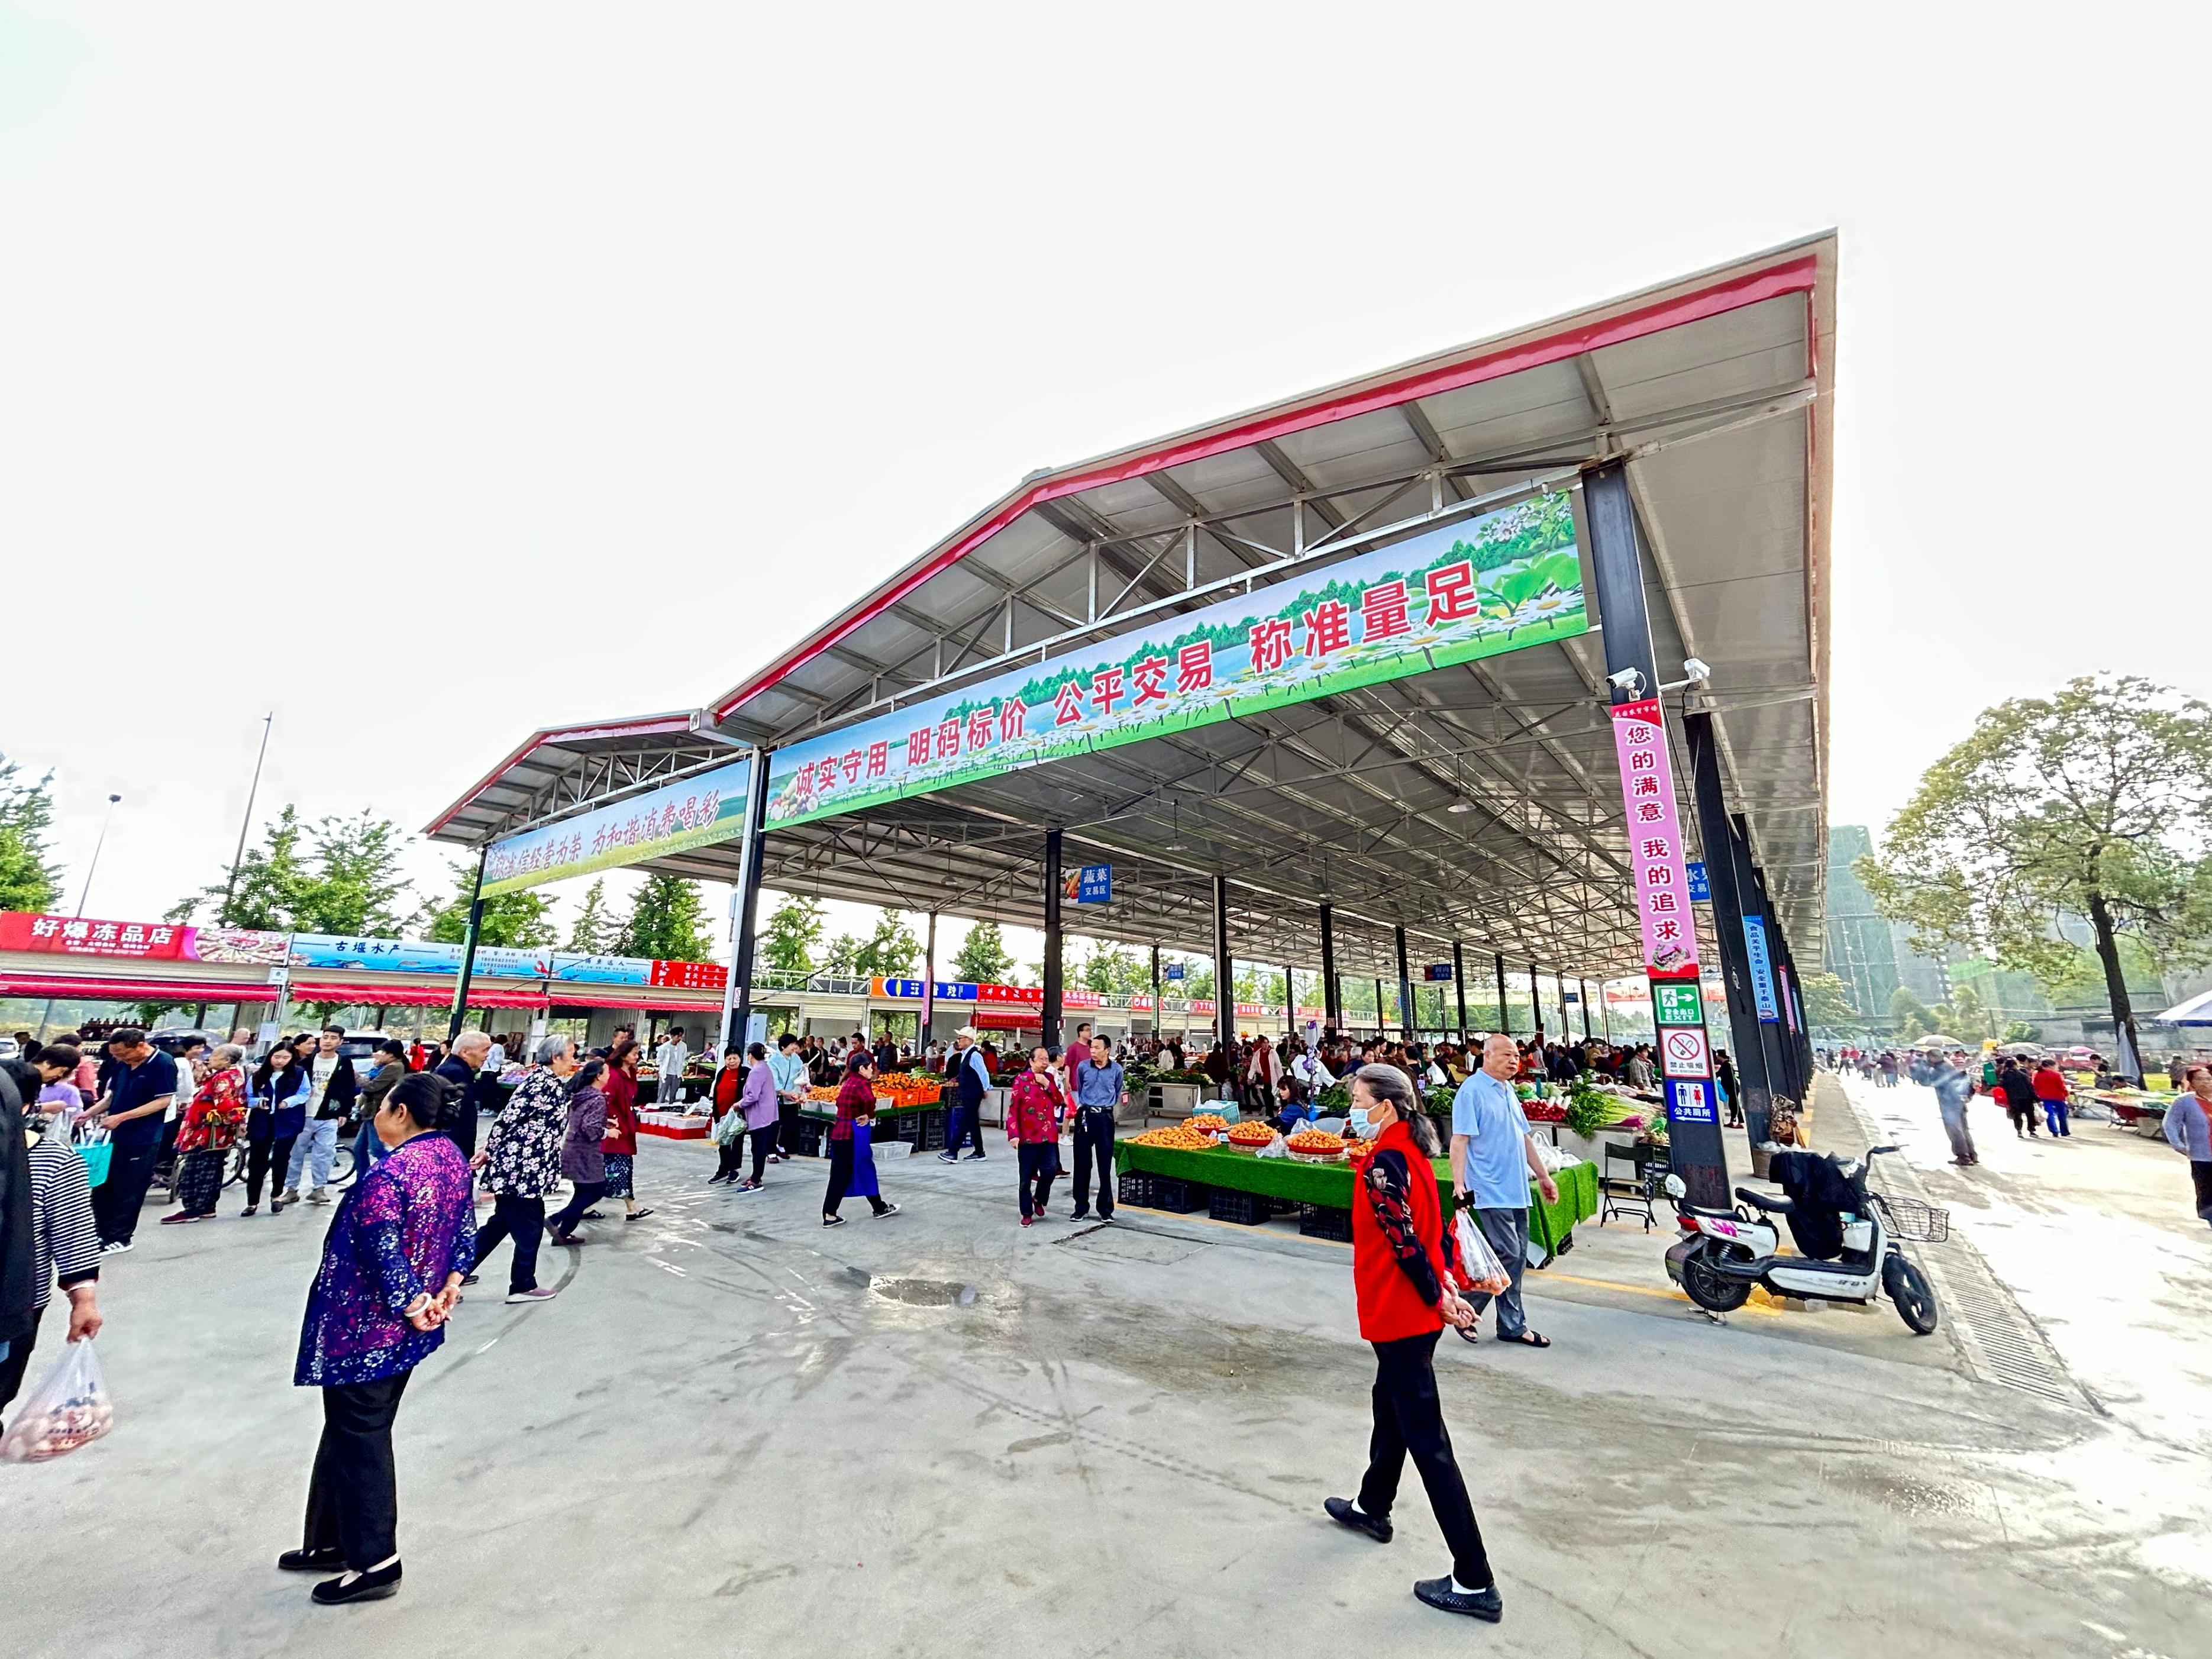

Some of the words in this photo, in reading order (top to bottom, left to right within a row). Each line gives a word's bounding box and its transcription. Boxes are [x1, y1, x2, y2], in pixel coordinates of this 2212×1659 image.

[795, 740, 889, 797] 诚实守用
[907, 701, 1028, 766] 明码标价
[1053, 641, 1213, 728] 公平交易
[1249, 561, 1480, 674] 称准量足
[1626, 725, 1665, 824] 您的满意
[590, 789, 720, 857] 为和谐消费喝彩
[1083, 868, 1107, 884] 蔬菜
[1085, 885, 1106, 896] 交易区
[1642, 838, 1681, 942] 我的追求
[31, 918, 174, 945] 好爆冻品店
[1749, 925, 1764, 965] 食品关乎生命
[335, 941, 401, 956] 古堰水产
[1755, 969, 1771, 1009] 安全重于泰山
[1670, 1061, 1704, 1070] 禁止吸烟
[1674, 1106, 1712, 1118] 公共厕所
